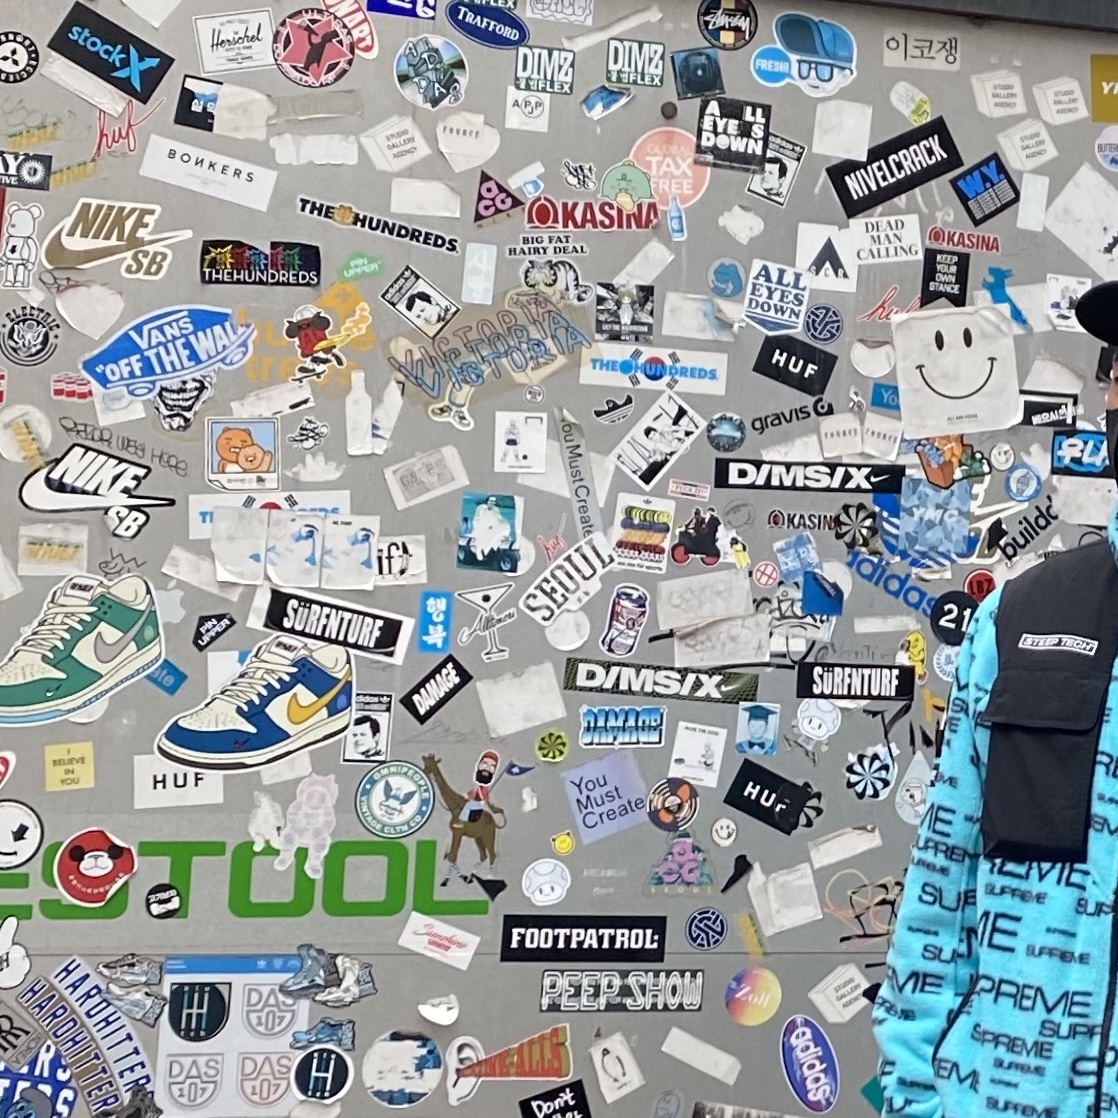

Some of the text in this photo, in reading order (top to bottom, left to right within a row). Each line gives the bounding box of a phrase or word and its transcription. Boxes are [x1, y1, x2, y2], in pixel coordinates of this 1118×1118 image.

[458, 7, 519, 40] TRAFFORD
[211, 29, 263, 52] Herschel
[68, 26, 160, 92] stockX
[517, 47, 573, 82] DIMZ
[608, 40, 663, 75] DIMZ
[93, 98, 165, 162] huf
[645, 156, 693, 177] TAX
[844, 134, 947, 200] NIVELCRACK
[651, 177, 694, 194] FREE
[66, 203, 158, 240] NIKE
[300, 199, 336, 219] THE
[563, 203, 660, 230] KASINA
[865, 218, 905, 233] DEAD
[870, 232, 903, 245] MAN
[508, 245, 587, 256] HAIRY DEAL
[522, 236, 572, 244] BIG FAT
[857, 243, 919, 260] CALLING
[947, 230, 1000, 253] KASINA
[125, 249, 168, 276] SB
[936, 254, 959, 264] KEEP
[936, 264, 957, 274] YOUR
[753, 264, 806, 292] ALL
[929, 282, 960, 294] STANCE
[935, 274, 955, 283] OWN
[751, 284, 804, 306] EYES
[747, 300, 802, 321] DOWN
[128, 312, 194, 346] VANS
[149, 343, 190, 372] THE
[590, 359, 620, 373] THE
[771, 349, 818, 378] HUF
[751, 405, 811, 435] gravis
[49, 448, 149, 496] NIKE
[106, 508, 148, 537] SB
[526, 538, 614, 621] SEOUL
[412, 662, 461, 716] DAMAGE
[152, 772, 205, 790] HUF
[570, 774, 608, 796] You
[575, 786, 623, 815] Must
[581, 797, 646, 829] Create
[541, 970, 702, 1011] PEEP SHOW
[169, 1058, 220, 1079] DAS
[240, 1056, 292, 1076] DAS
[790, 1026, 835, 1104] adidas
